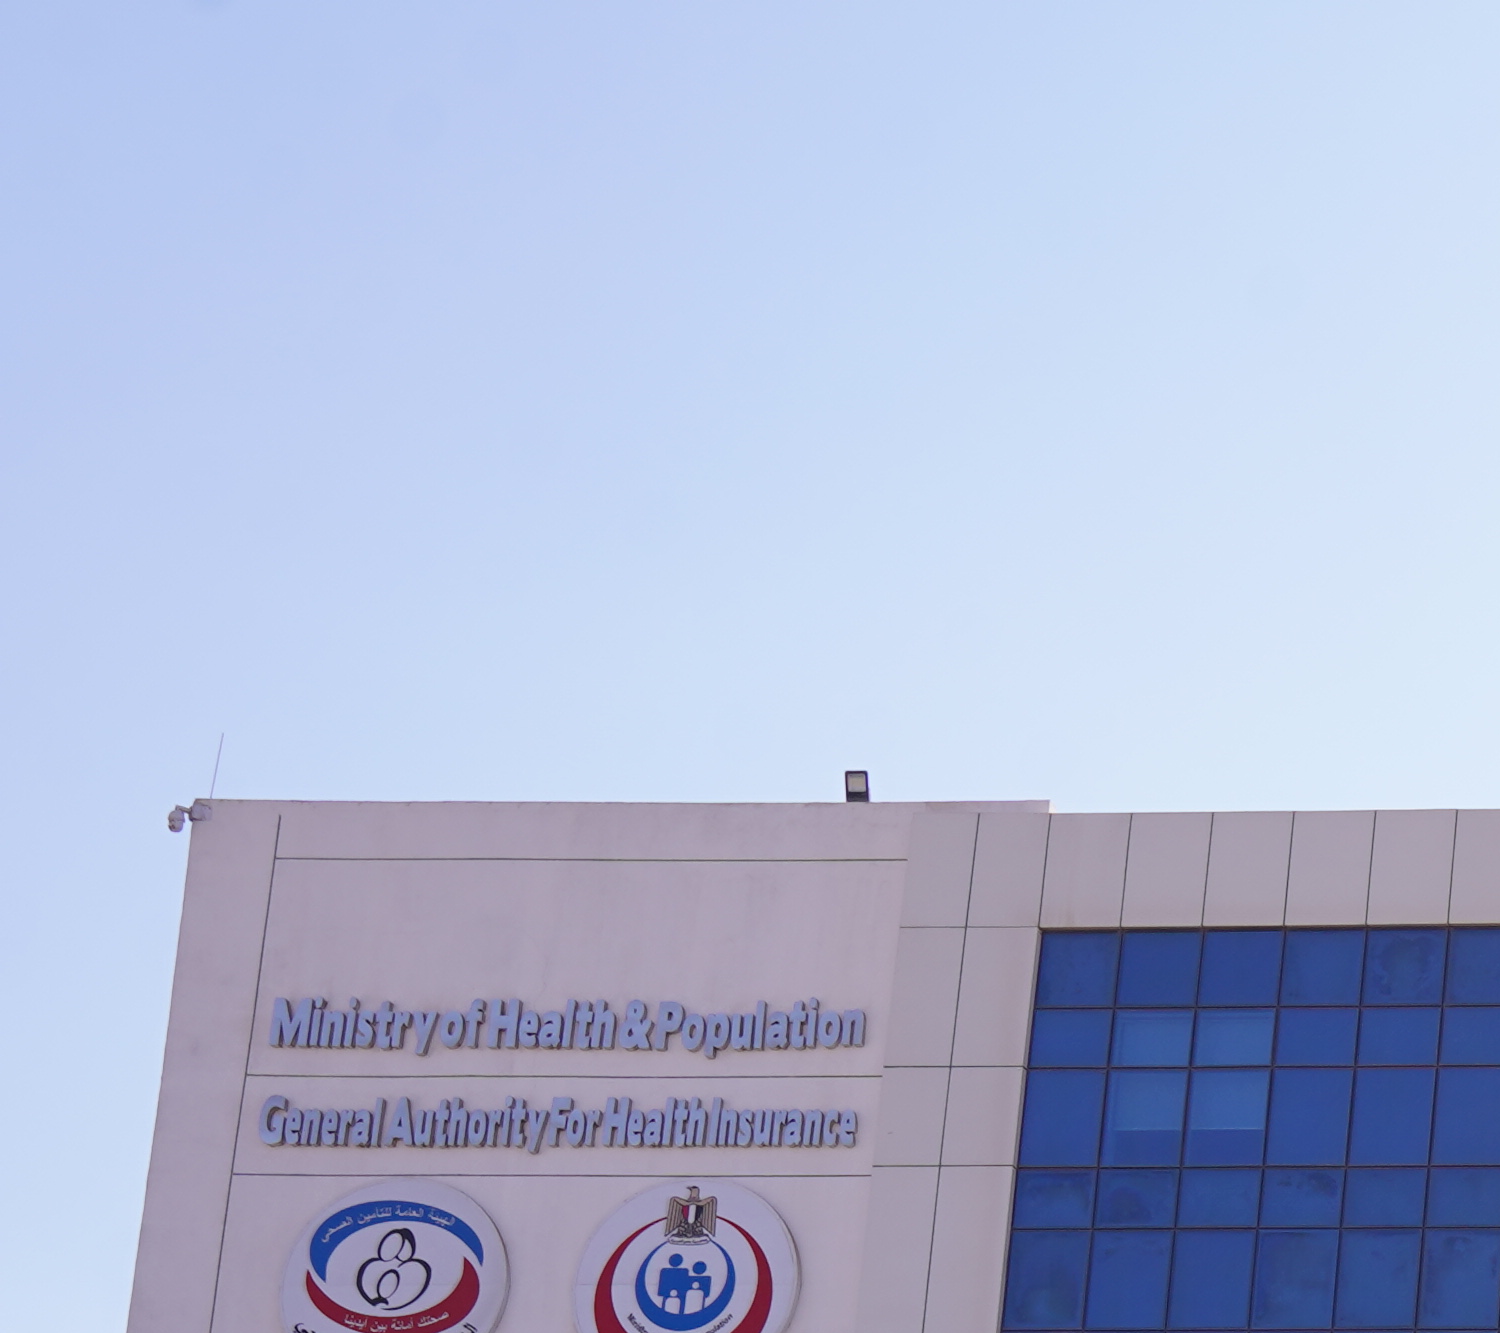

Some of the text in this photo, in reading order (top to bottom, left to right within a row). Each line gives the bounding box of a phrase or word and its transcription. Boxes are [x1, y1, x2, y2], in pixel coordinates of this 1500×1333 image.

[269, 997, 866, 1059] Ministry of Health & Population
[258, 1095, 858, 1155] General Authority For Health Insurance
